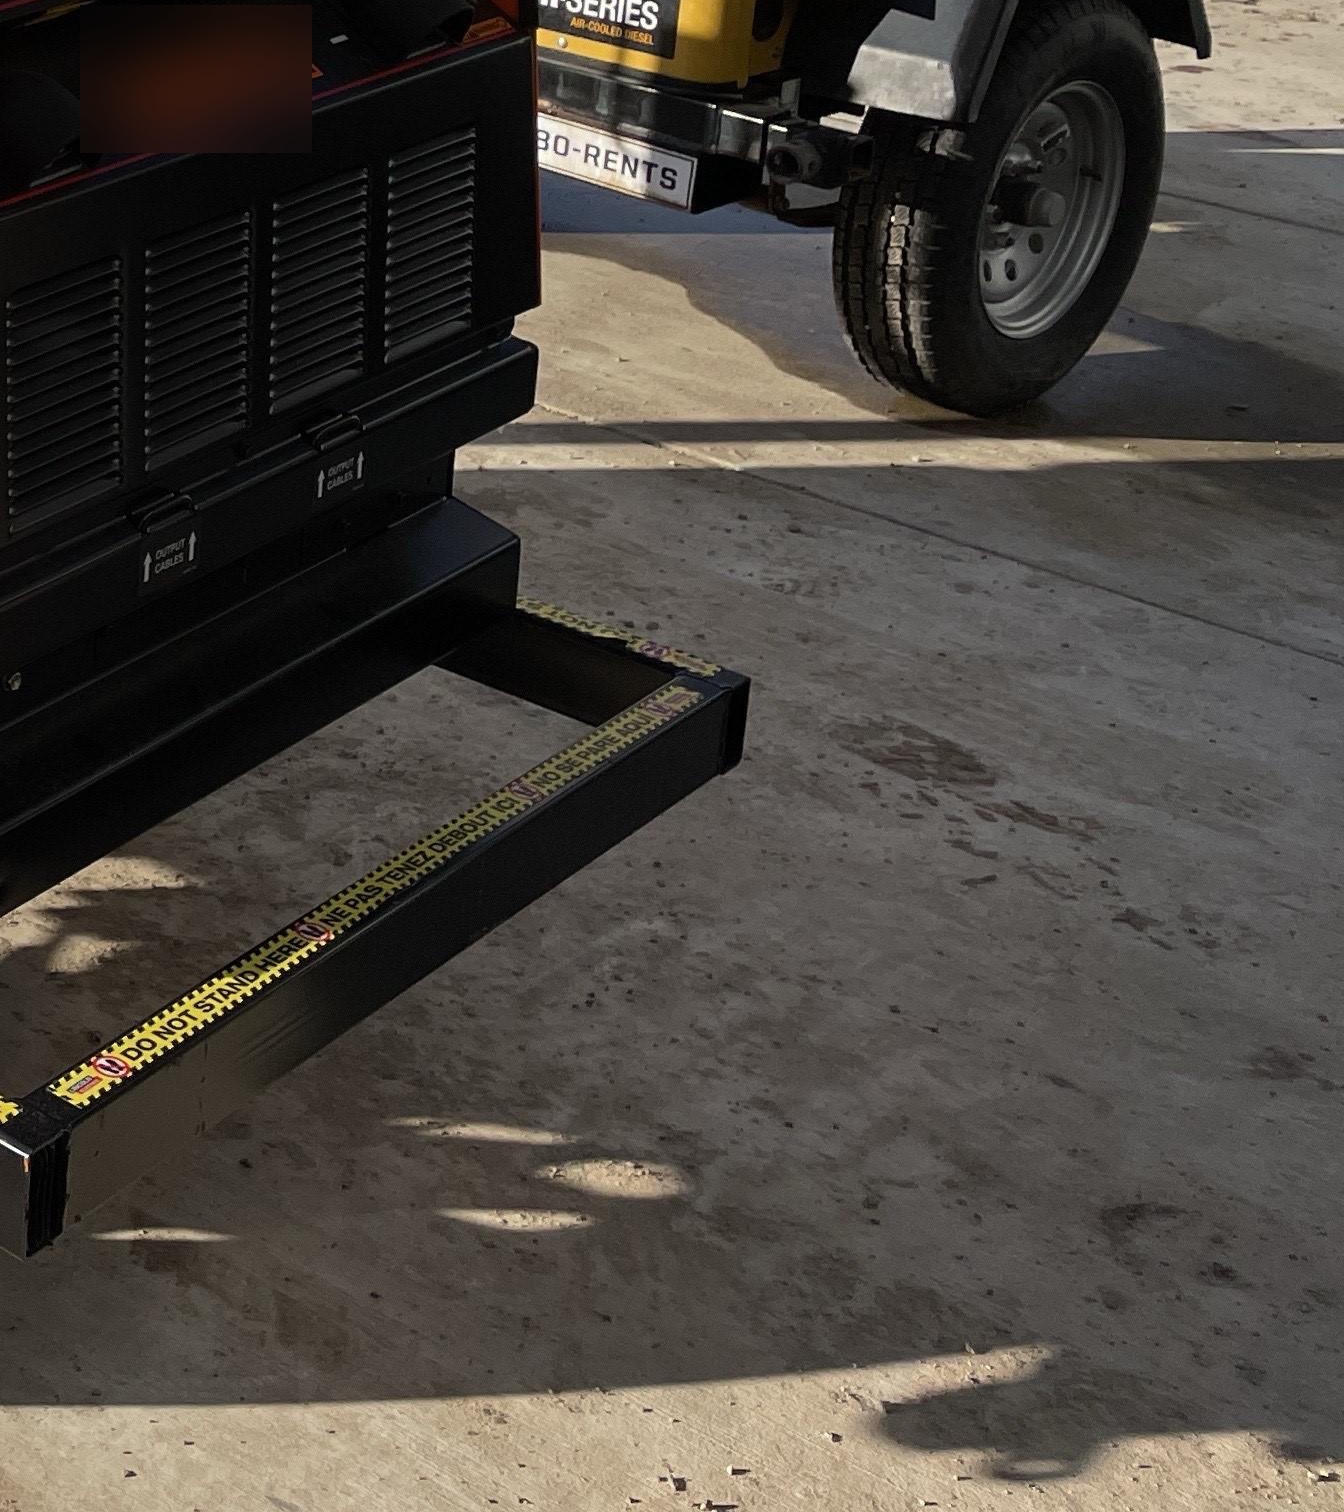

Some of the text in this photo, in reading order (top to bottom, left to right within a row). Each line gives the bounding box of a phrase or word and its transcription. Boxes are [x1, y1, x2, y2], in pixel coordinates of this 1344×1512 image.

[569, 16, 654, 46] AIR-COOLED DIESEL
[327, 457, 355, 478] OUTPUT
[327, 470, 354, 491] CABLES
[155, 537, 187, 560] OUTPUT
[154, 552, 184, 574] CABLES
[531, 770, 562, 789] NO
[554, 757, 584, 774] SE
[582, 734, 622, 761] PARE
[318, 797, 522, 928] NE PAS TENEZ DEBOUT ICI
[120, 935, 309, 1061] DO NOT STAND HERE
